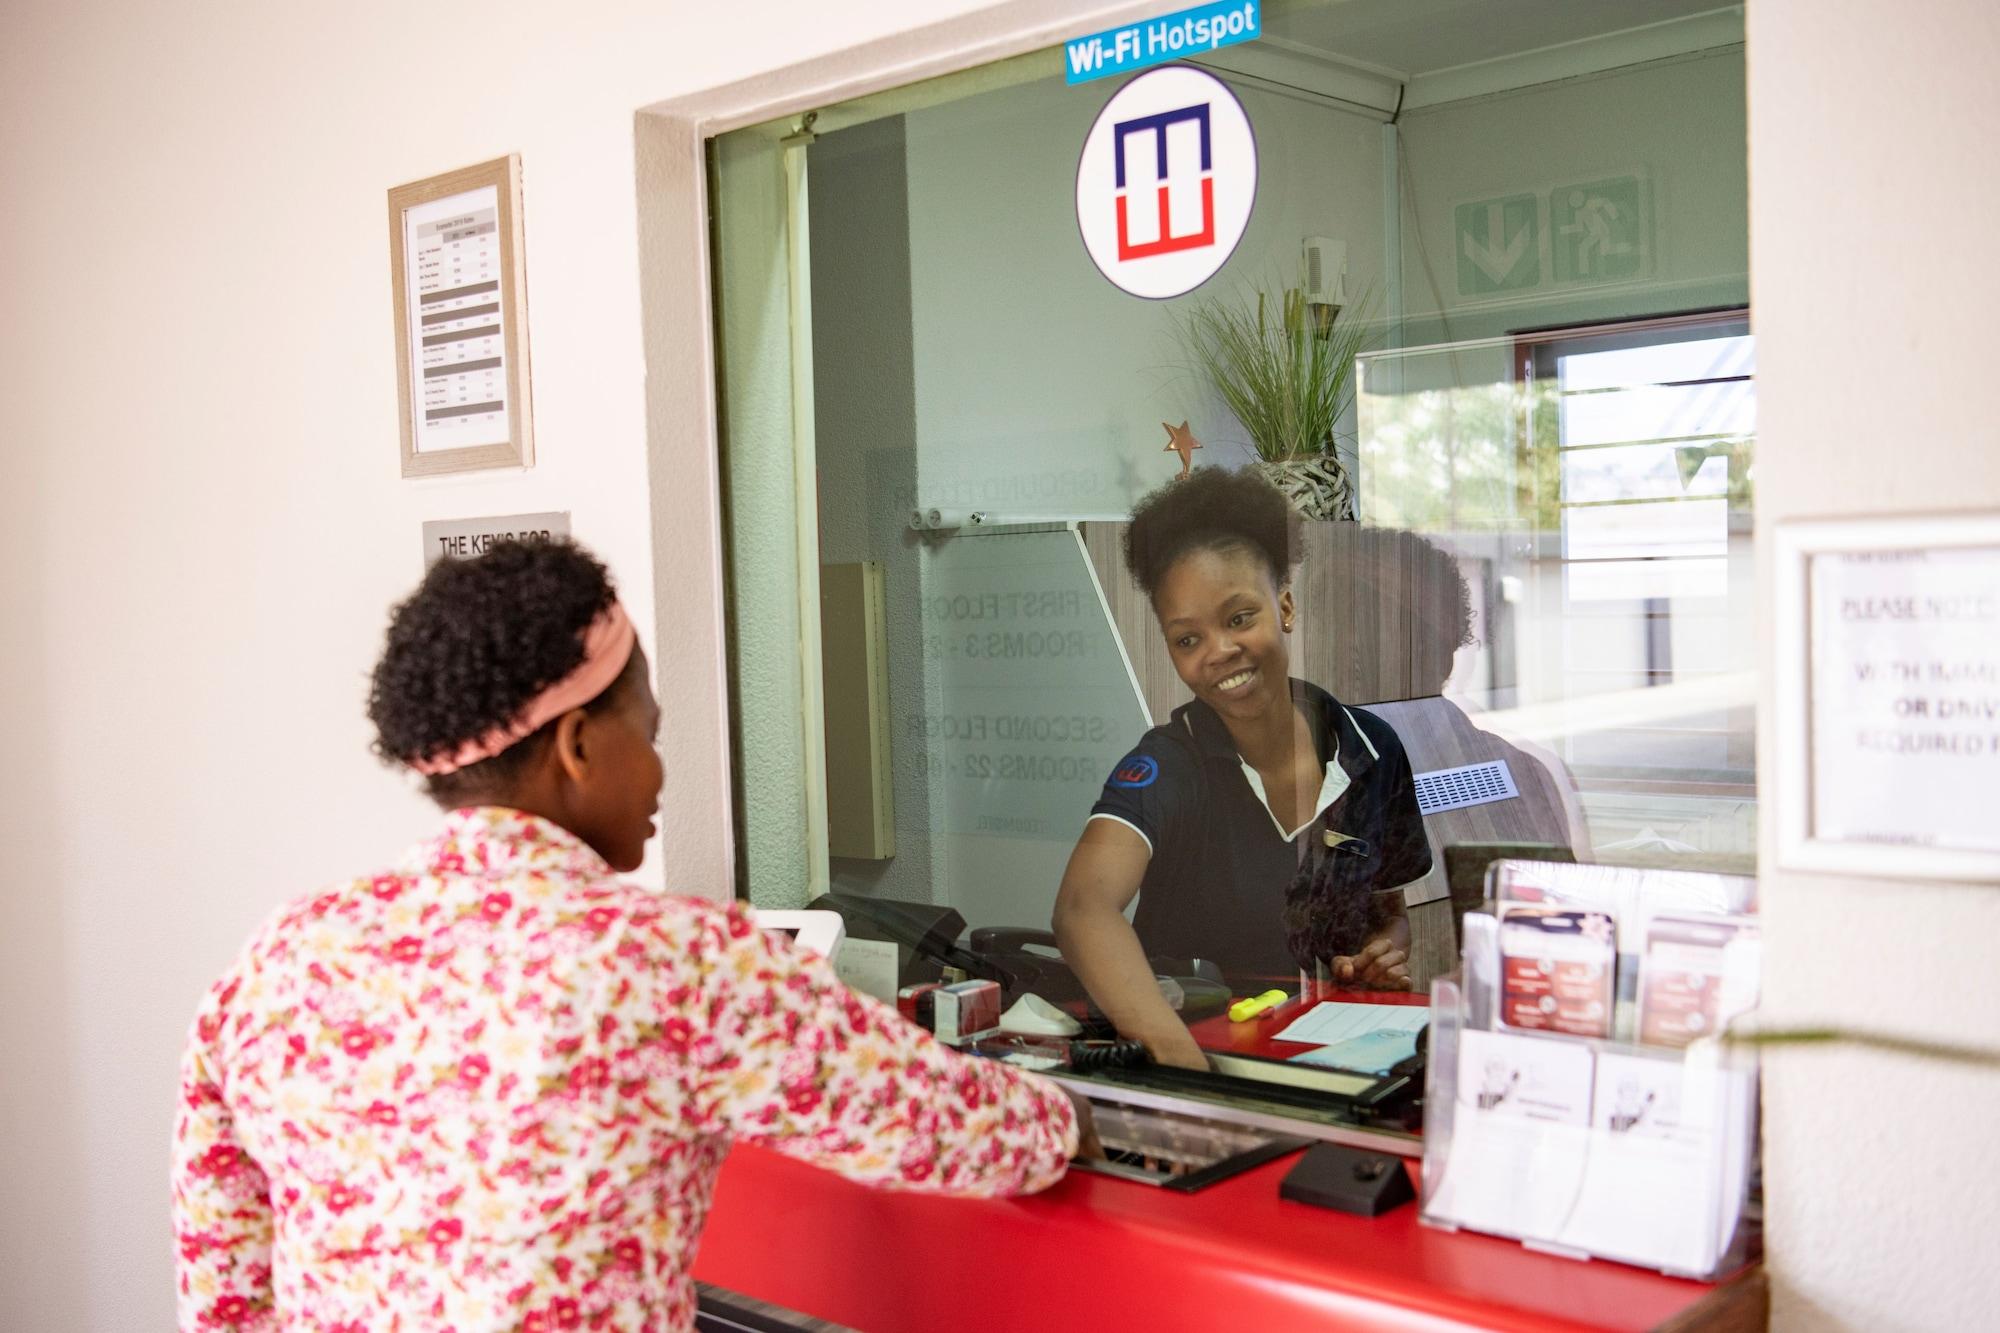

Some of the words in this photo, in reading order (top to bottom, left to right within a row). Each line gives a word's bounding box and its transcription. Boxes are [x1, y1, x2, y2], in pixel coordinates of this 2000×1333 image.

[1068, 28, 1141, 75] Wi-Fi
[1148, 2, 1256, 56] Hotspot
[439, 535, 468, 556] THE
[1842, 596, 1919, 620] PLEASE
[1892, 697, 1930, 718] OR
[1856, 729, 1984, 756] REQUIRED
